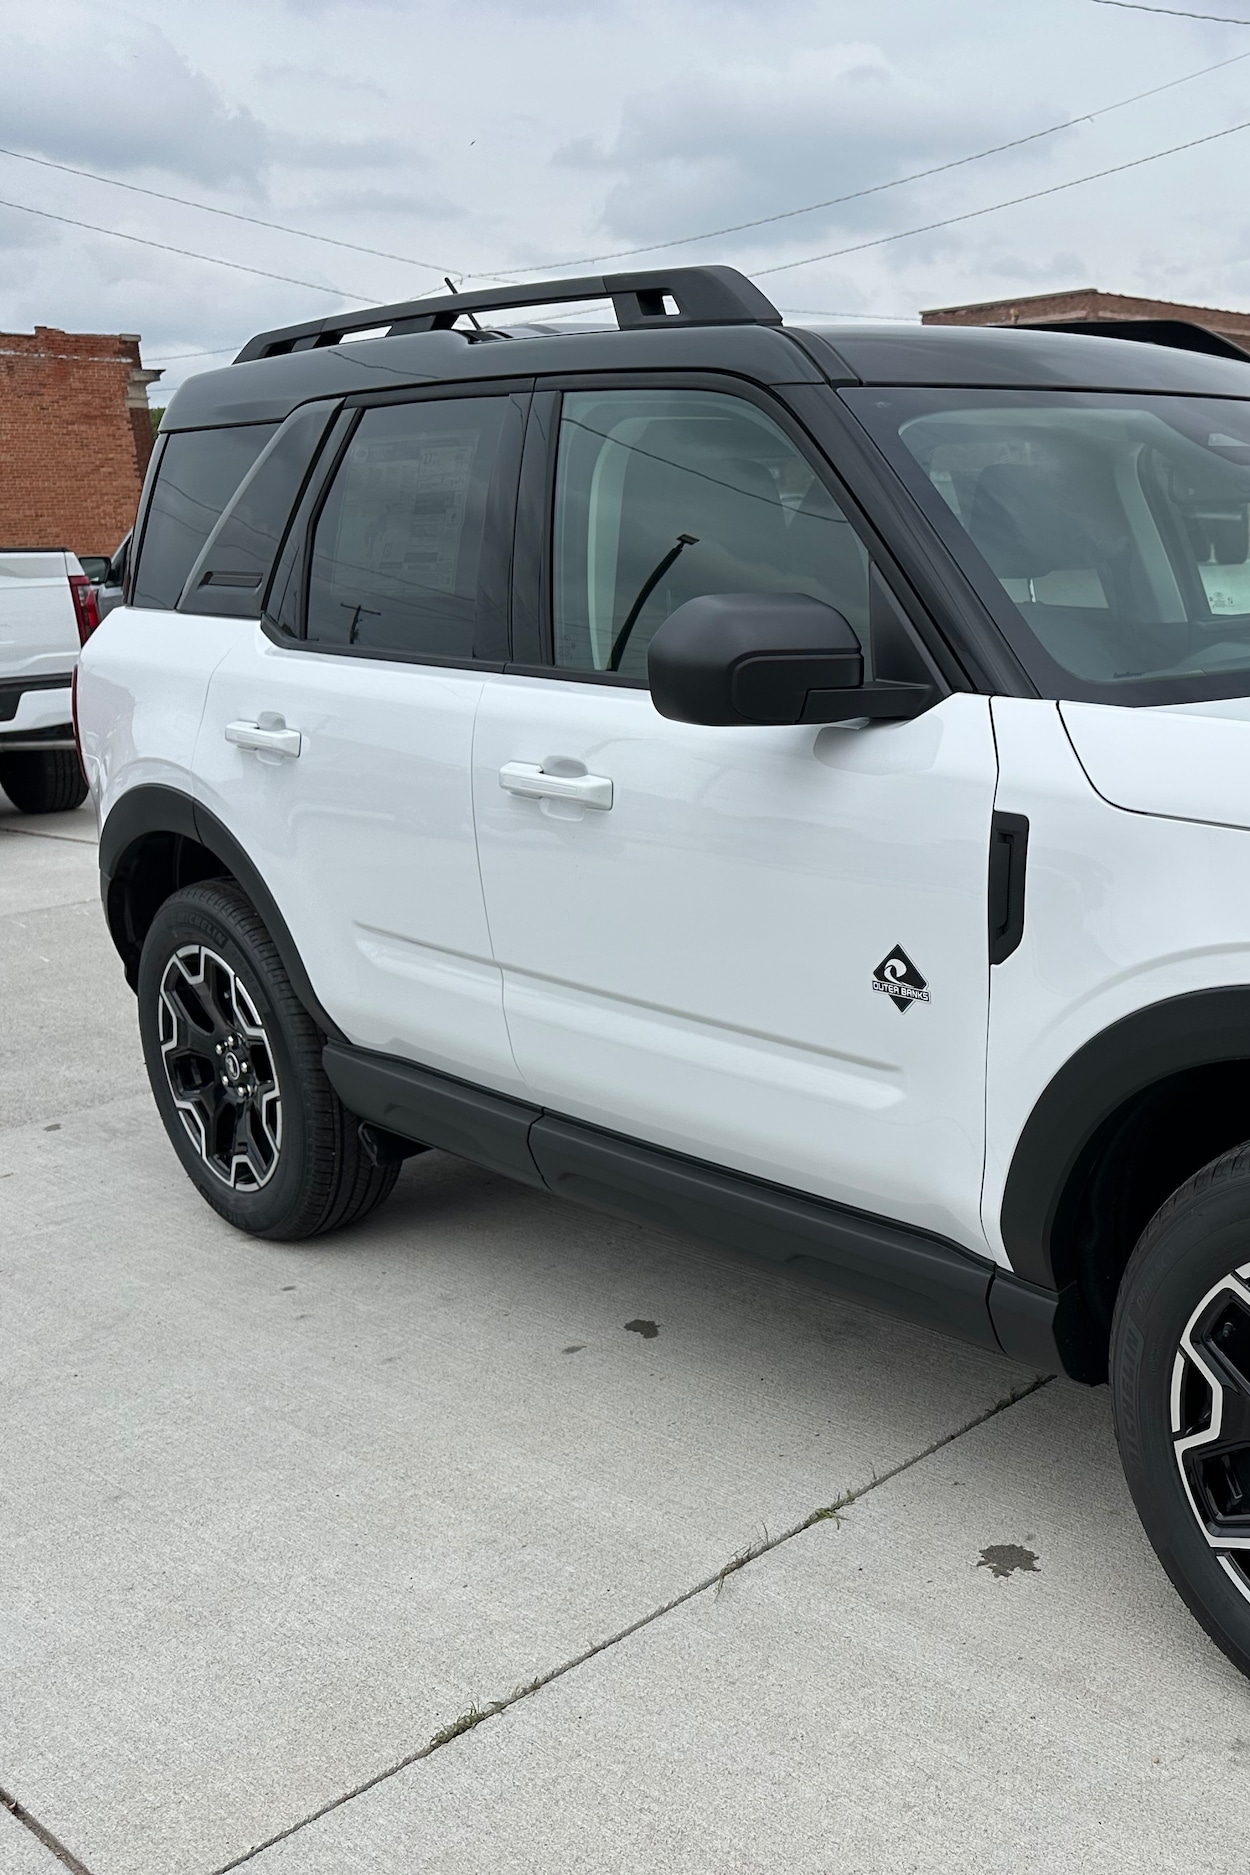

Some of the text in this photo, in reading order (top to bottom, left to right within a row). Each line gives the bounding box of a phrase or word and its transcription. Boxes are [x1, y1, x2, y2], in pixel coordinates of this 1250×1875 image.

[176, 911, 226, 945] MICHELIN
[873, 981, 929, 1001] OUTER BANKS
